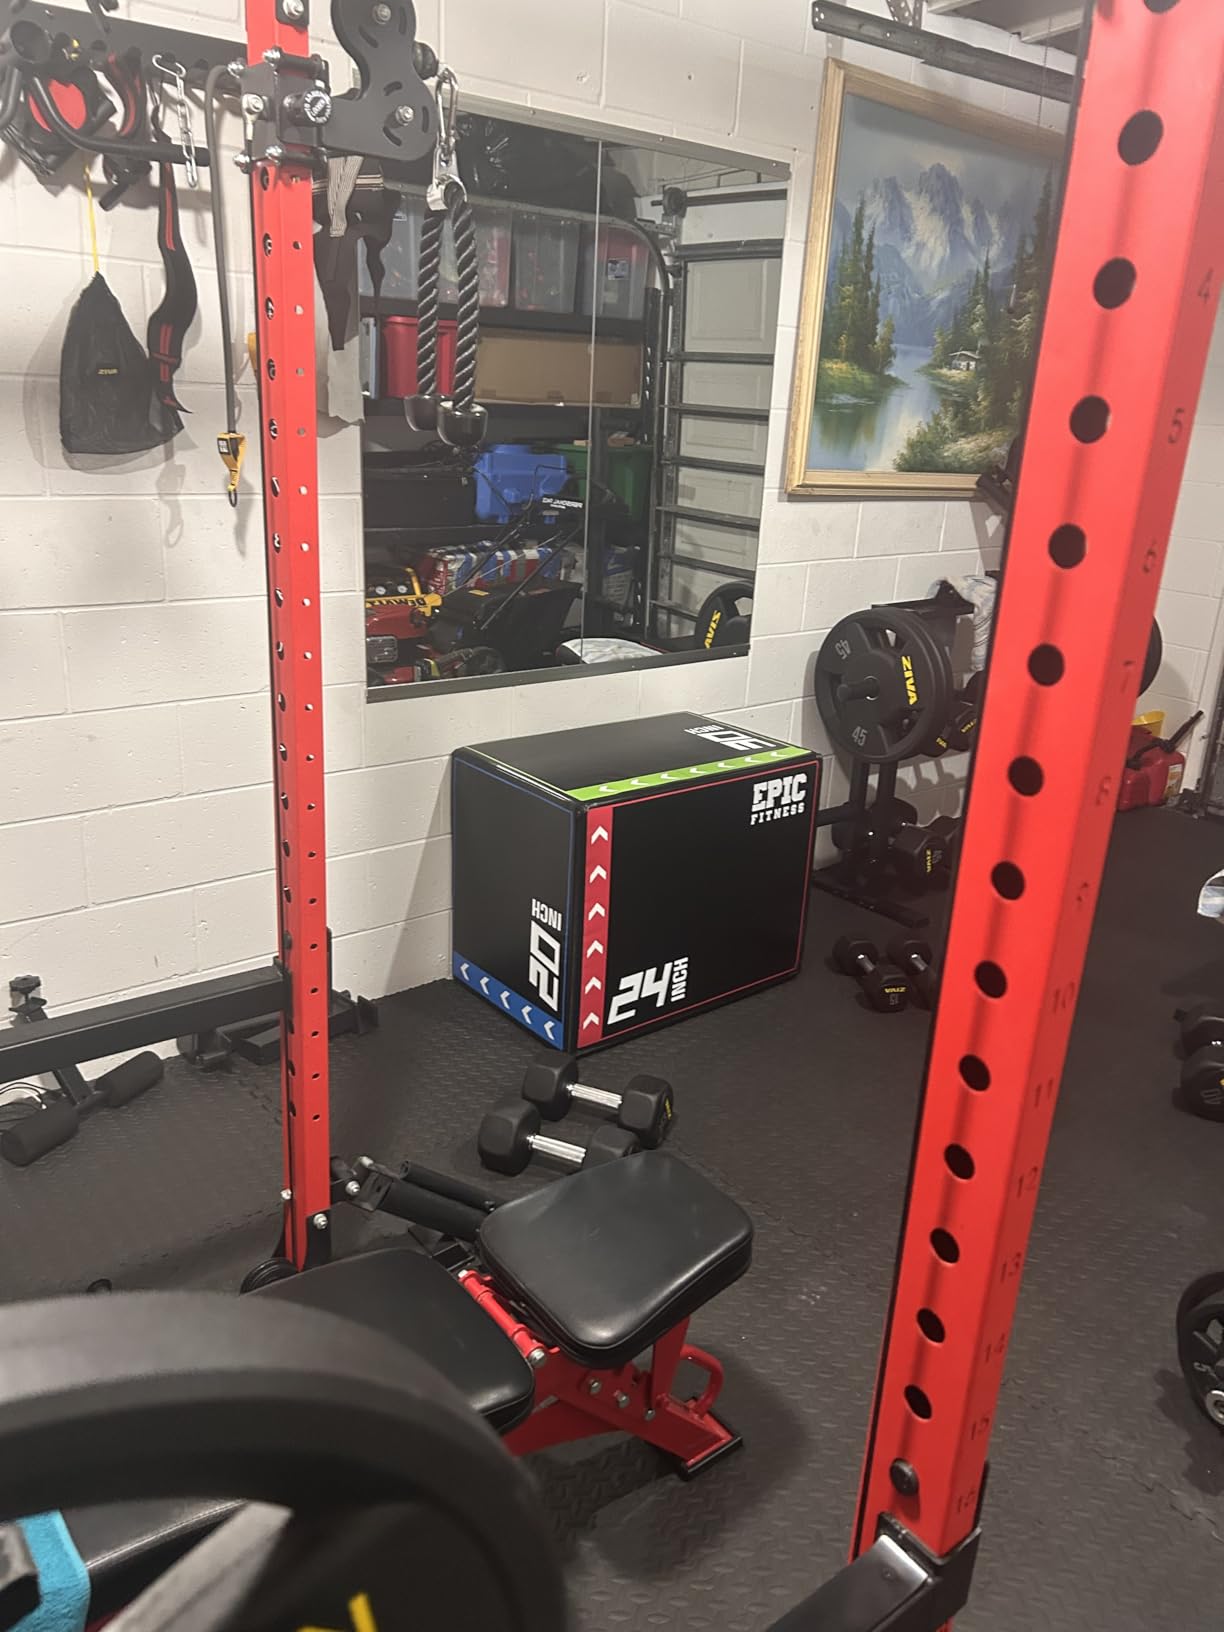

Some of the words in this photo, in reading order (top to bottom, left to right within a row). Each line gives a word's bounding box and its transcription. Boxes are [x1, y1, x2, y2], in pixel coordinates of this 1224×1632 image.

[835, 639, 851, 661] 45
[901, 655, 918, 706] ZIVA
[697, 730, 777, 751] 30
[851, 725, 869, 747] 45
[751, 772, 808, 812] EPIC
[750, 802, 806, 826] FITNESS
[531, 898, 563, 932] INCH
[528, 920, 561, 1013] 20
[670, 956, 689, 1002] INCH
[606, 962, 673, 1025] 24
